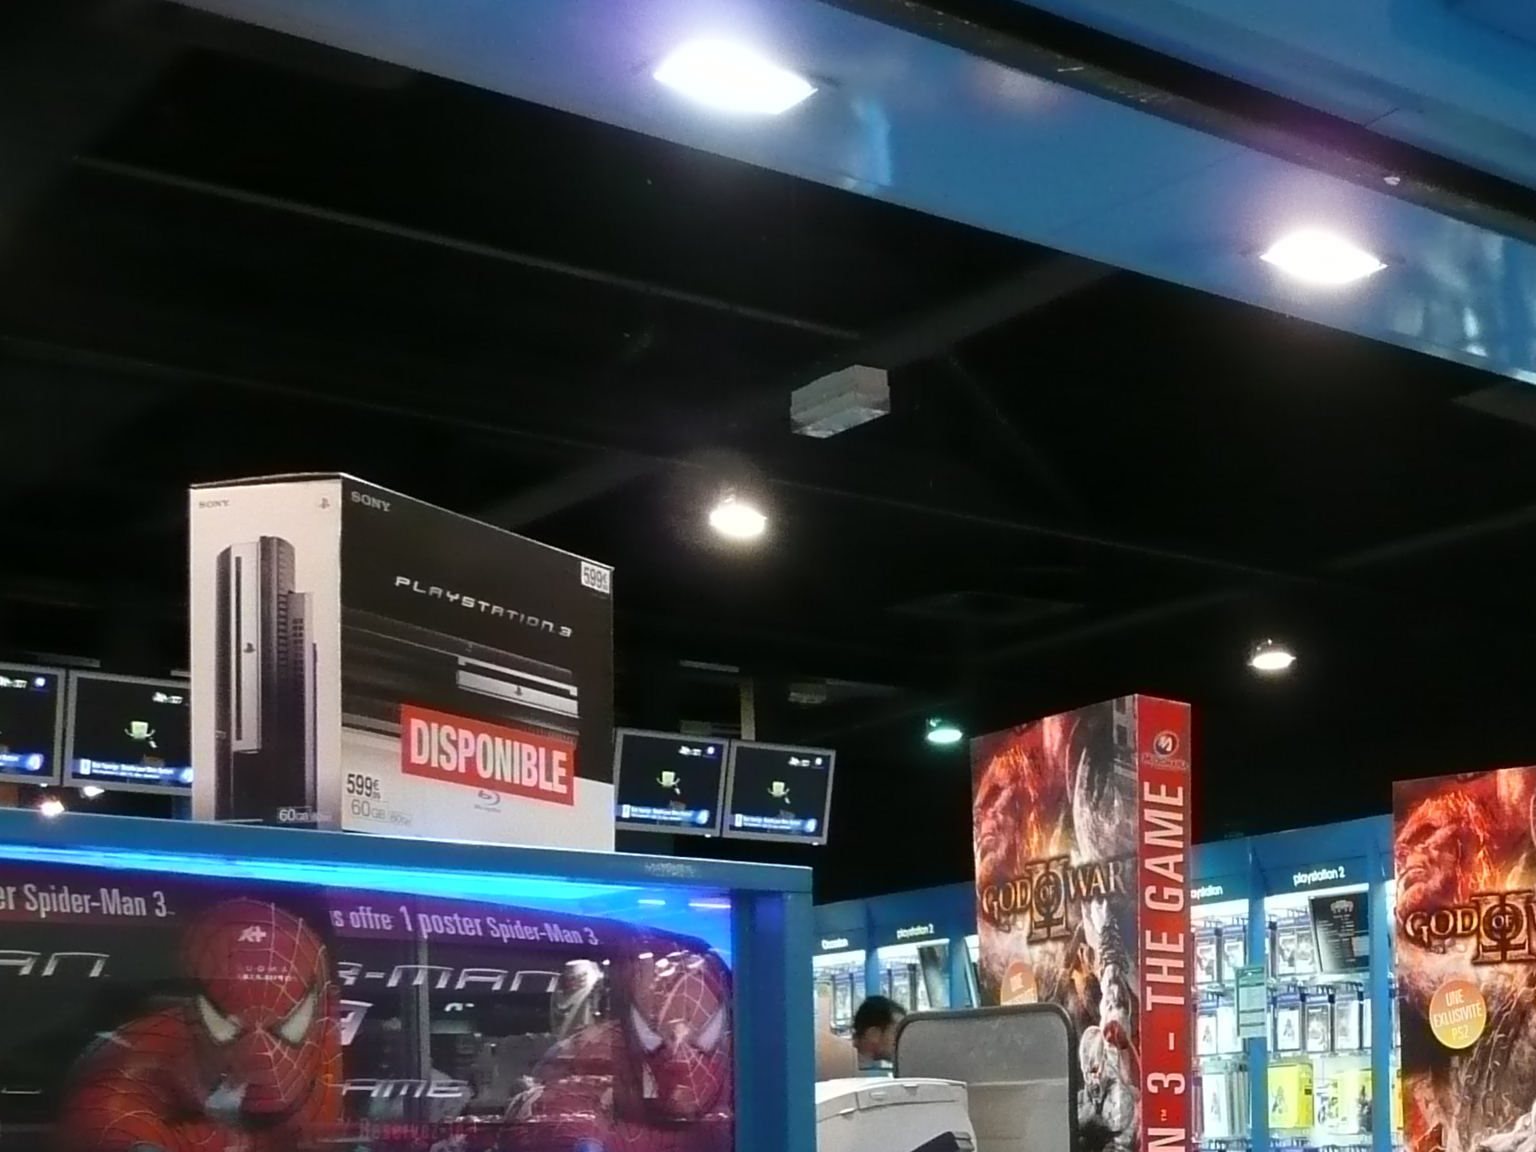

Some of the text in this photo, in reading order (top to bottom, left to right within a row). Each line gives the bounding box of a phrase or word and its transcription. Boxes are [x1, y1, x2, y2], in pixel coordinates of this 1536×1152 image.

[198, 499, 230, 509] SONY
[350, 491, 392, 512] SONY
[395, 576, 555, 631] PLAYSTATION
[410, 718, 569, 794] DISPONIBLE
[1143, 781, 1184, 912] GAME
[983, 880, 1031, 921] GOD
[1066, 861, 1127, 899] WAR
[1293, 866, 1346, 887] playstation 2
[24, 884, 167, 918] Spider-Man 3
[350, 906, 598, 946] offre 1 poster Spider-Man 3
[1405, 908, 1479, 946] GOD
[1491, 912, 1513, 931] OF
[1145, 930, 1185, 1011] THE
[1445, 989, 1465, 1006] UNE
[1451, 1024, 1470, 1041] PS2
[1147, 1072, 1186, 1095] 3
